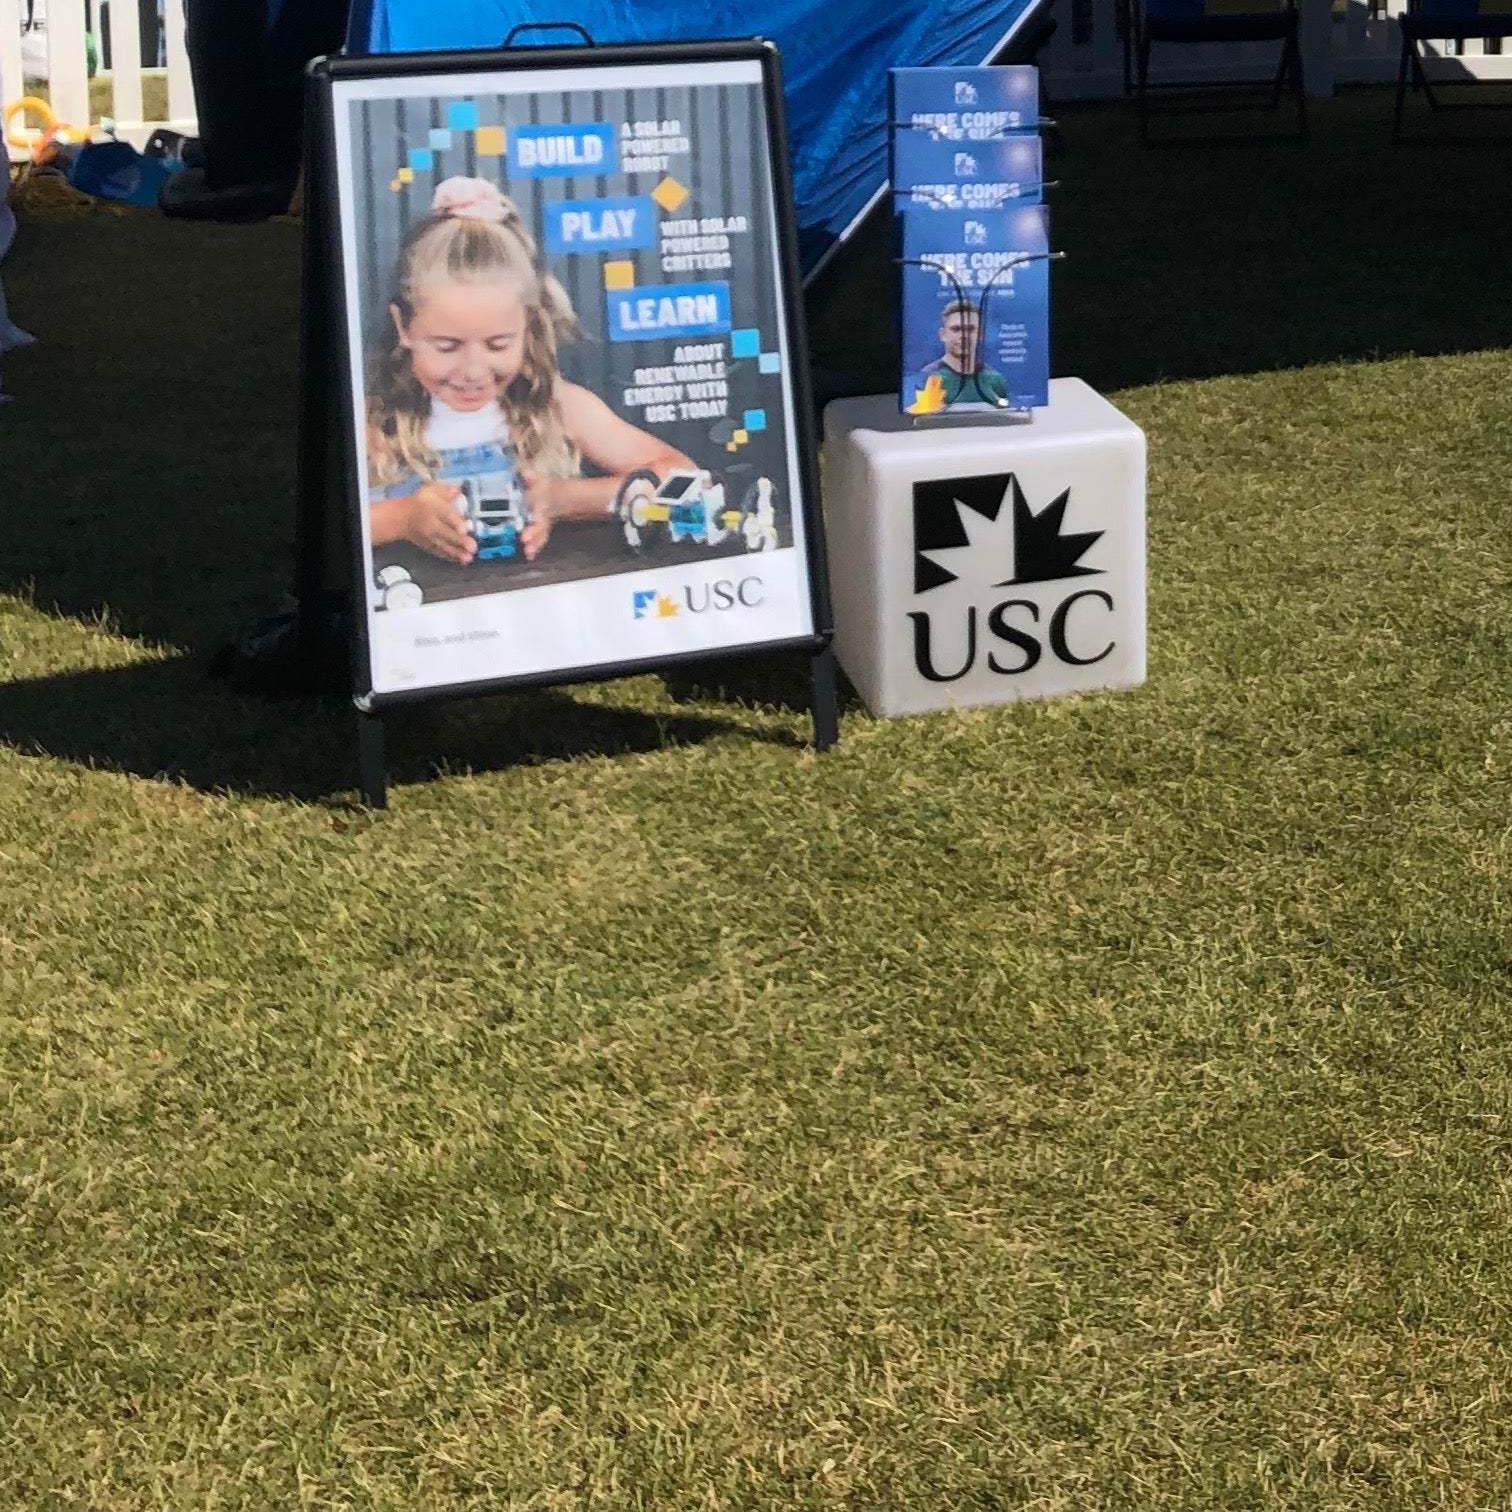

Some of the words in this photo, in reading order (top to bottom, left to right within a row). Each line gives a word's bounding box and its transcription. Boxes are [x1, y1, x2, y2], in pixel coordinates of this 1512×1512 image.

[621, 122, 632, 137] A
[517, 134, 604, 168] BUILD
[561, 208, 637, 243] PLAY
[620, 293, 718, 330] LEARN
[673, 342, 725, 363] ABOUT
[645, 404, 677, 423] USC
[679, 399, 728, 420] TODAY
[684, 575, 765, 614] USC
[906, 589, 1116, 682] USC
